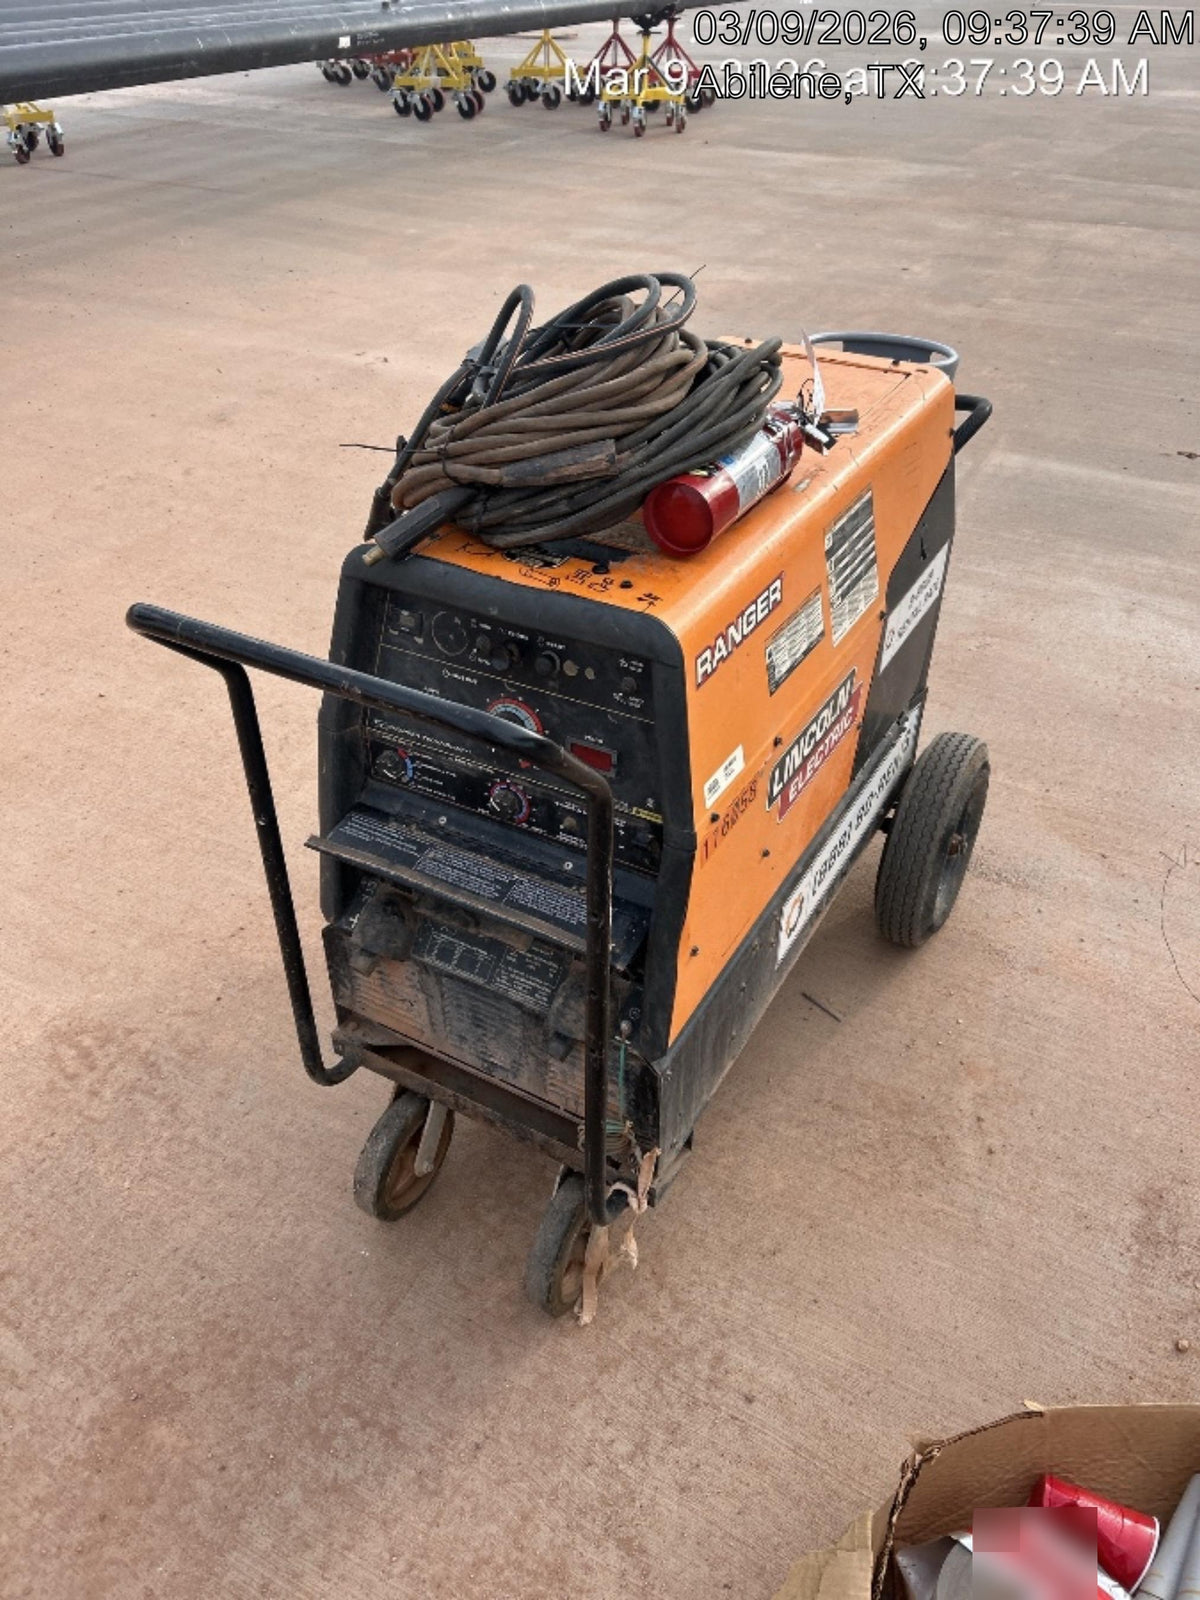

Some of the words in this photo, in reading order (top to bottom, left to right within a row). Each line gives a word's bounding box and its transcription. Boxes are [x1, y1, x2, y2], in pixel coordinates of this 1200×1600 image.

[696, 577, 783, 687] RANGER
[772, 677, 852, 798] LINCOLN
[788, 705, 854, 803] ELECTRIC
